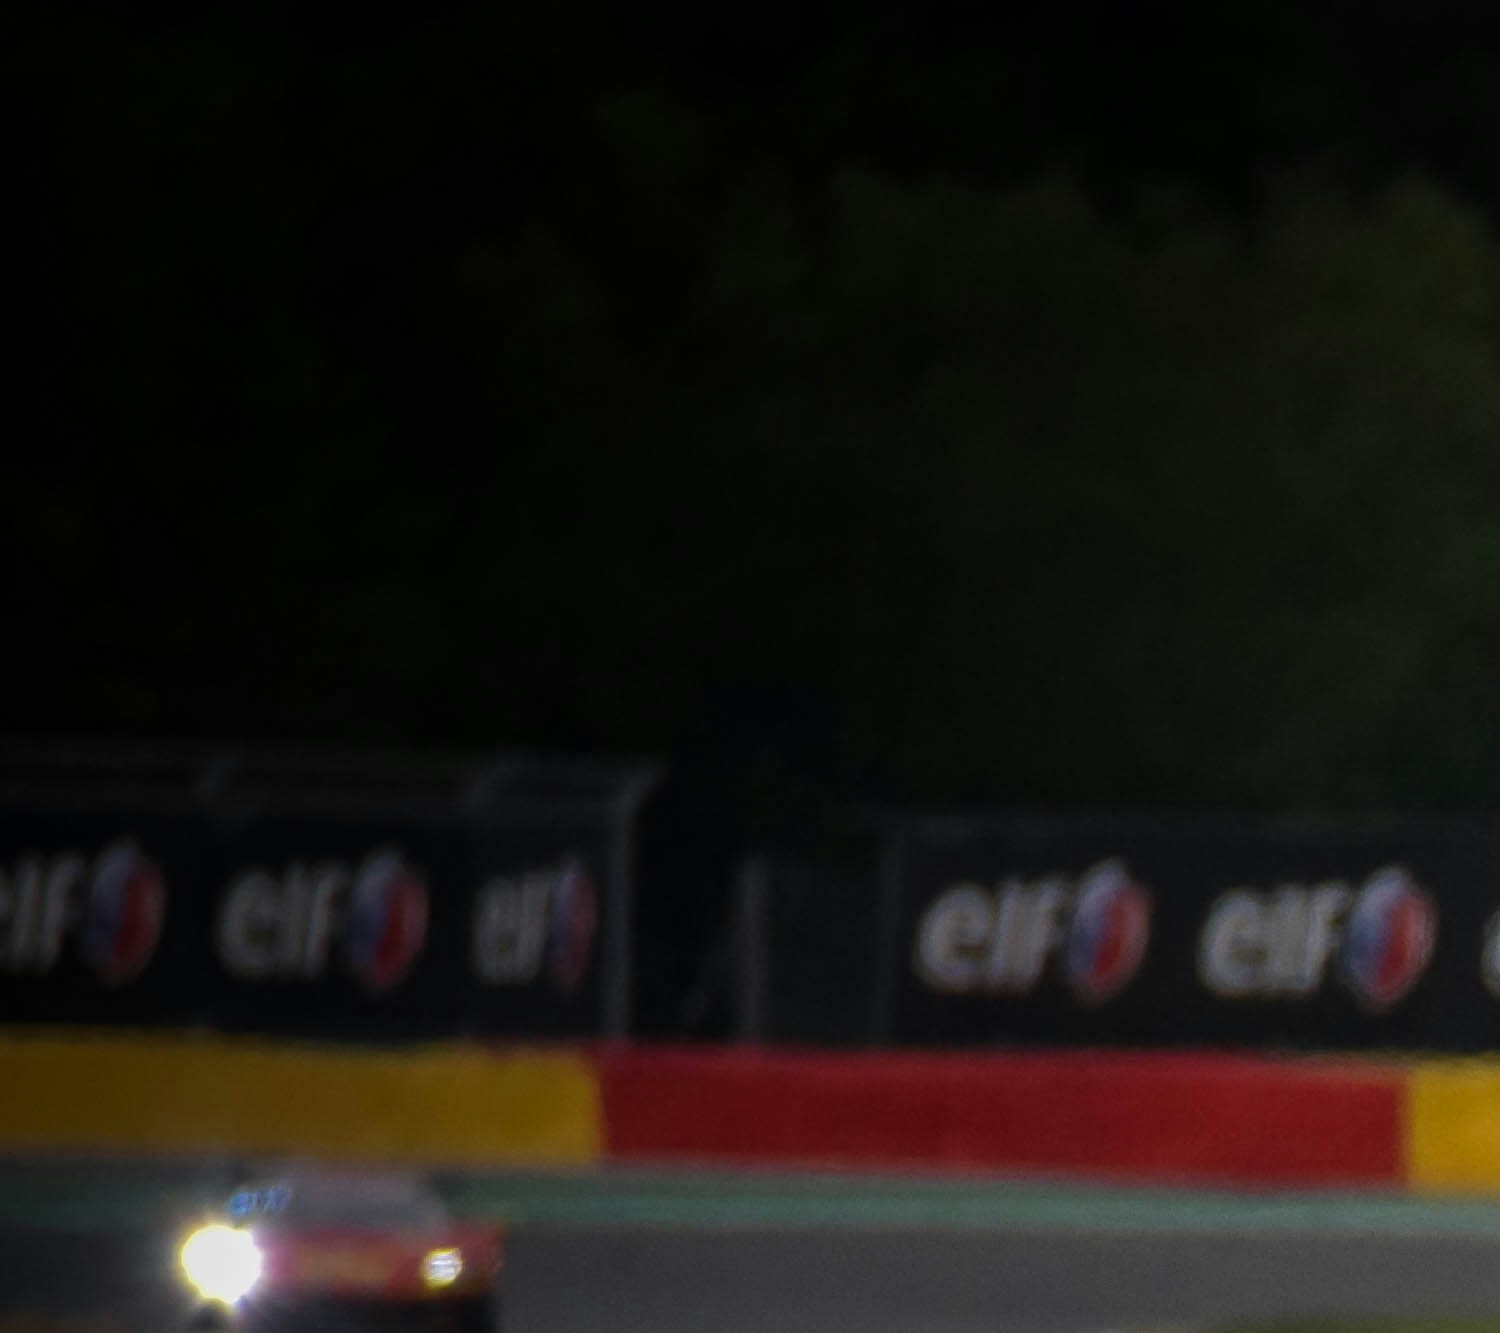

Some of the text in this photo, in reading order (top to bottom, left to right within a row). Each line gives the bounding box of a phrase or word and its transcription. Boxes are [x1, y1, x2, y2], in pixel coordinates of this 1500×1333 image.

[0, 848, 86, 975] lf
[912, 870, 1072, 998] elf
[1196, 880, 1352, 1000] elf
